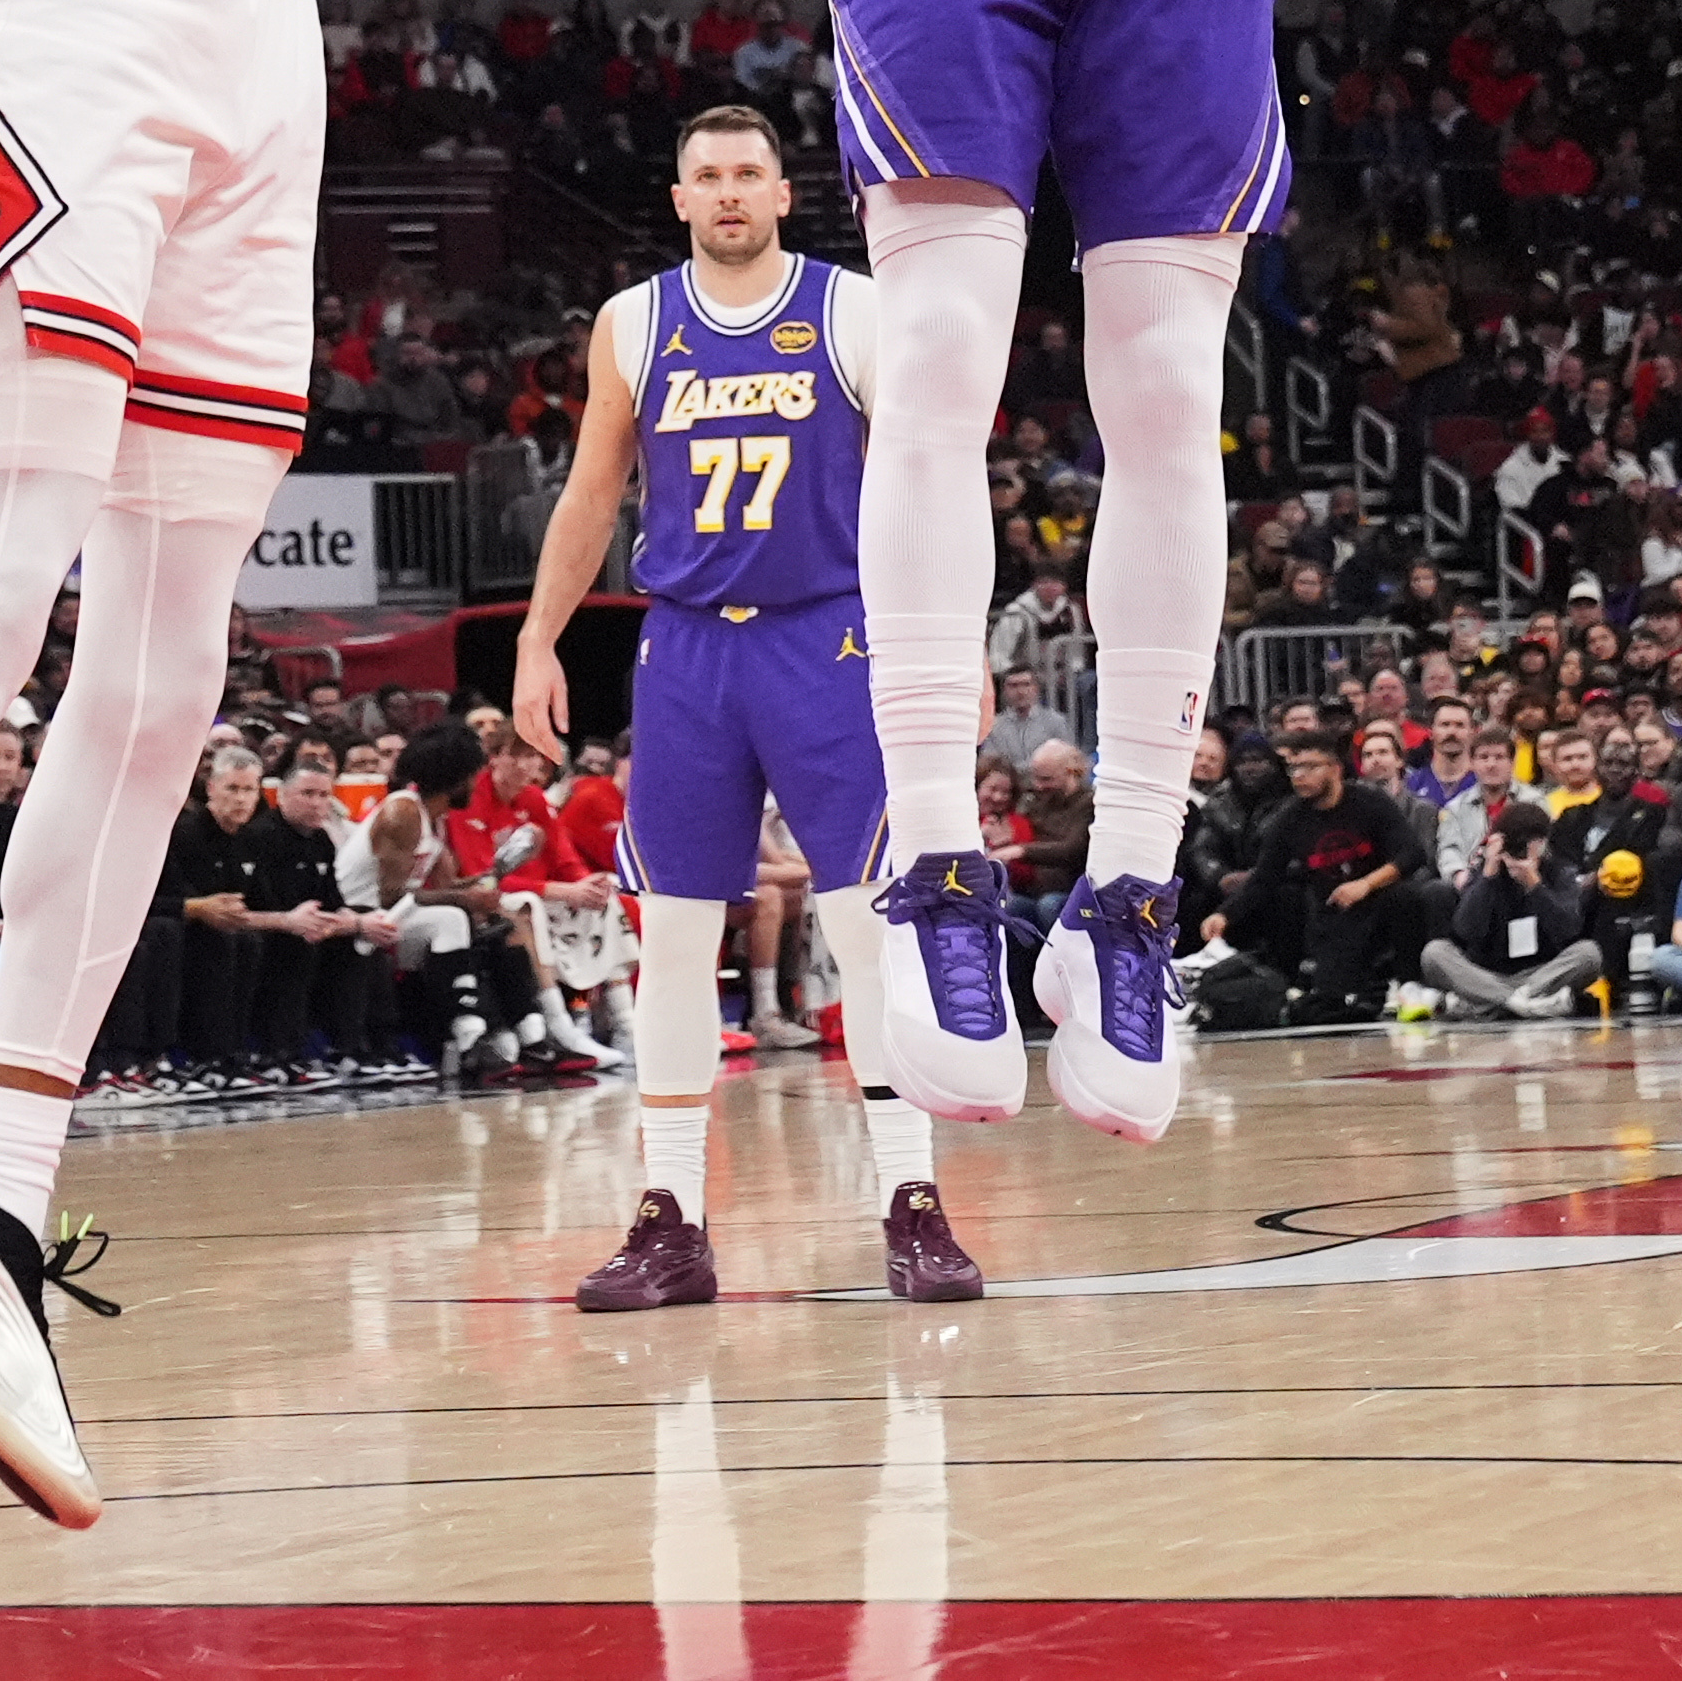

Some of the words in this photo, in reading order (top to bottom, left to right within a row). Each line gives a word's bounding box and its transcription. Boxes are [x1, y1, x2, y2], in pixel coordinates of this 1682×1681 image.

[654, 369, 817, 433] LAKERS
[689, 435, 792, 534] 77
[253, 519, 356, 567] cate
